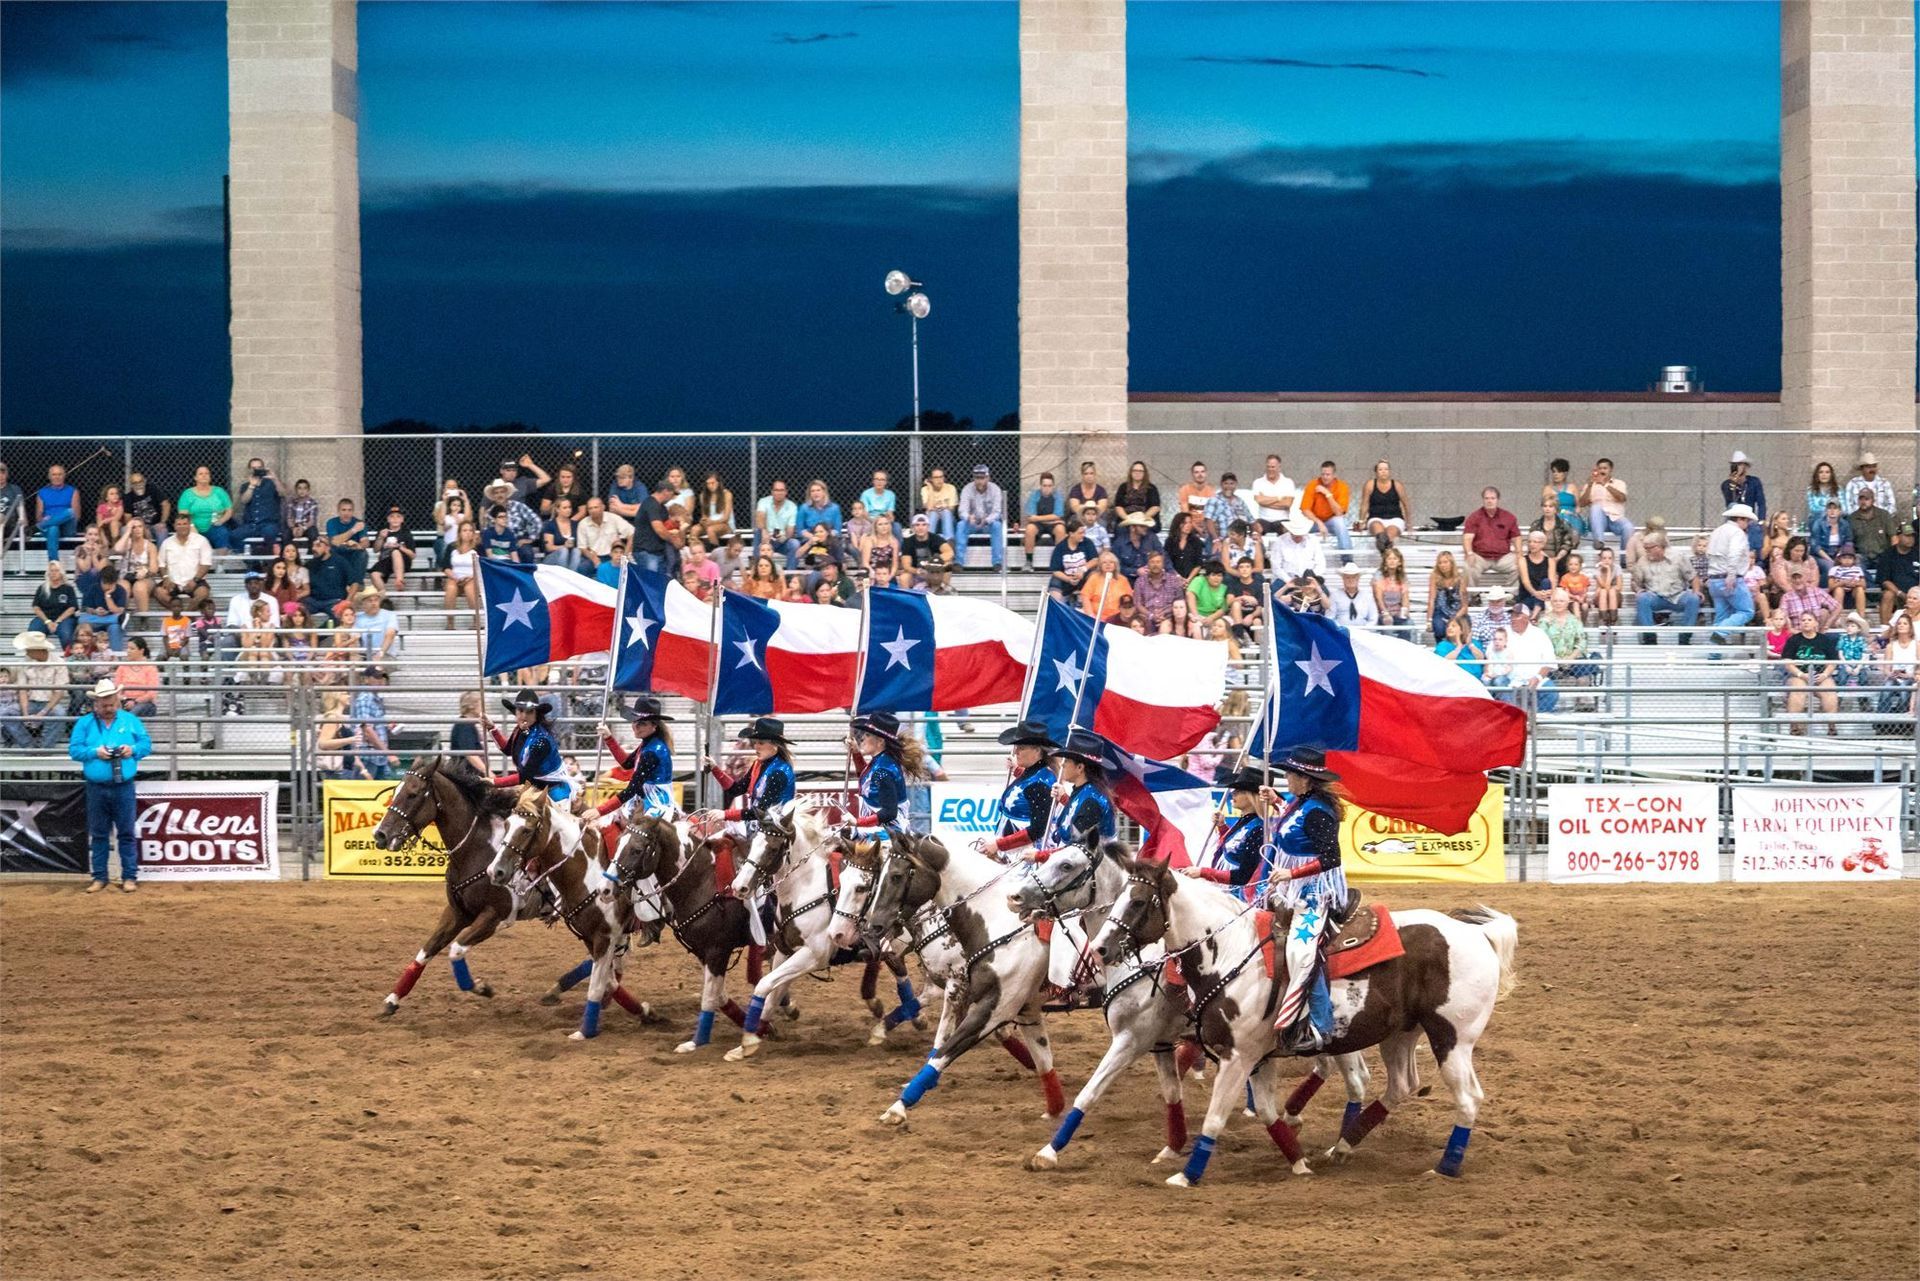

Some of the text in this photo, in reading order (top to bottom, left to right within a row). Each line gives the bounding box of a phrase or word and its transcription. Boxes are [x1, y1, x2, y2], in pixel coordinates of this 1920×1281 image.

[1585, 797, 1682, 813] TEX-CON
[1772, 798, 1865, 813] JOHNSON'S
[134, 801, 259, 838] Allens
[334, 812, 384, 834] MAS
[939, 798, 1004, 832] EQUI
[1559, 817, 1707, 834] OIL COMPANY
[1742, 816, 1895, 835] FARM EQUIPMENT
[141, 839, 258, 861] BOOTS
[1422, 840, 1474, 852] EXPRESS
[384, 855, 449, 867] 352.929
[1567, 850, 1700, 871] 800-266-3798
[1742, 856, 1834, 870] 512.365.5476
